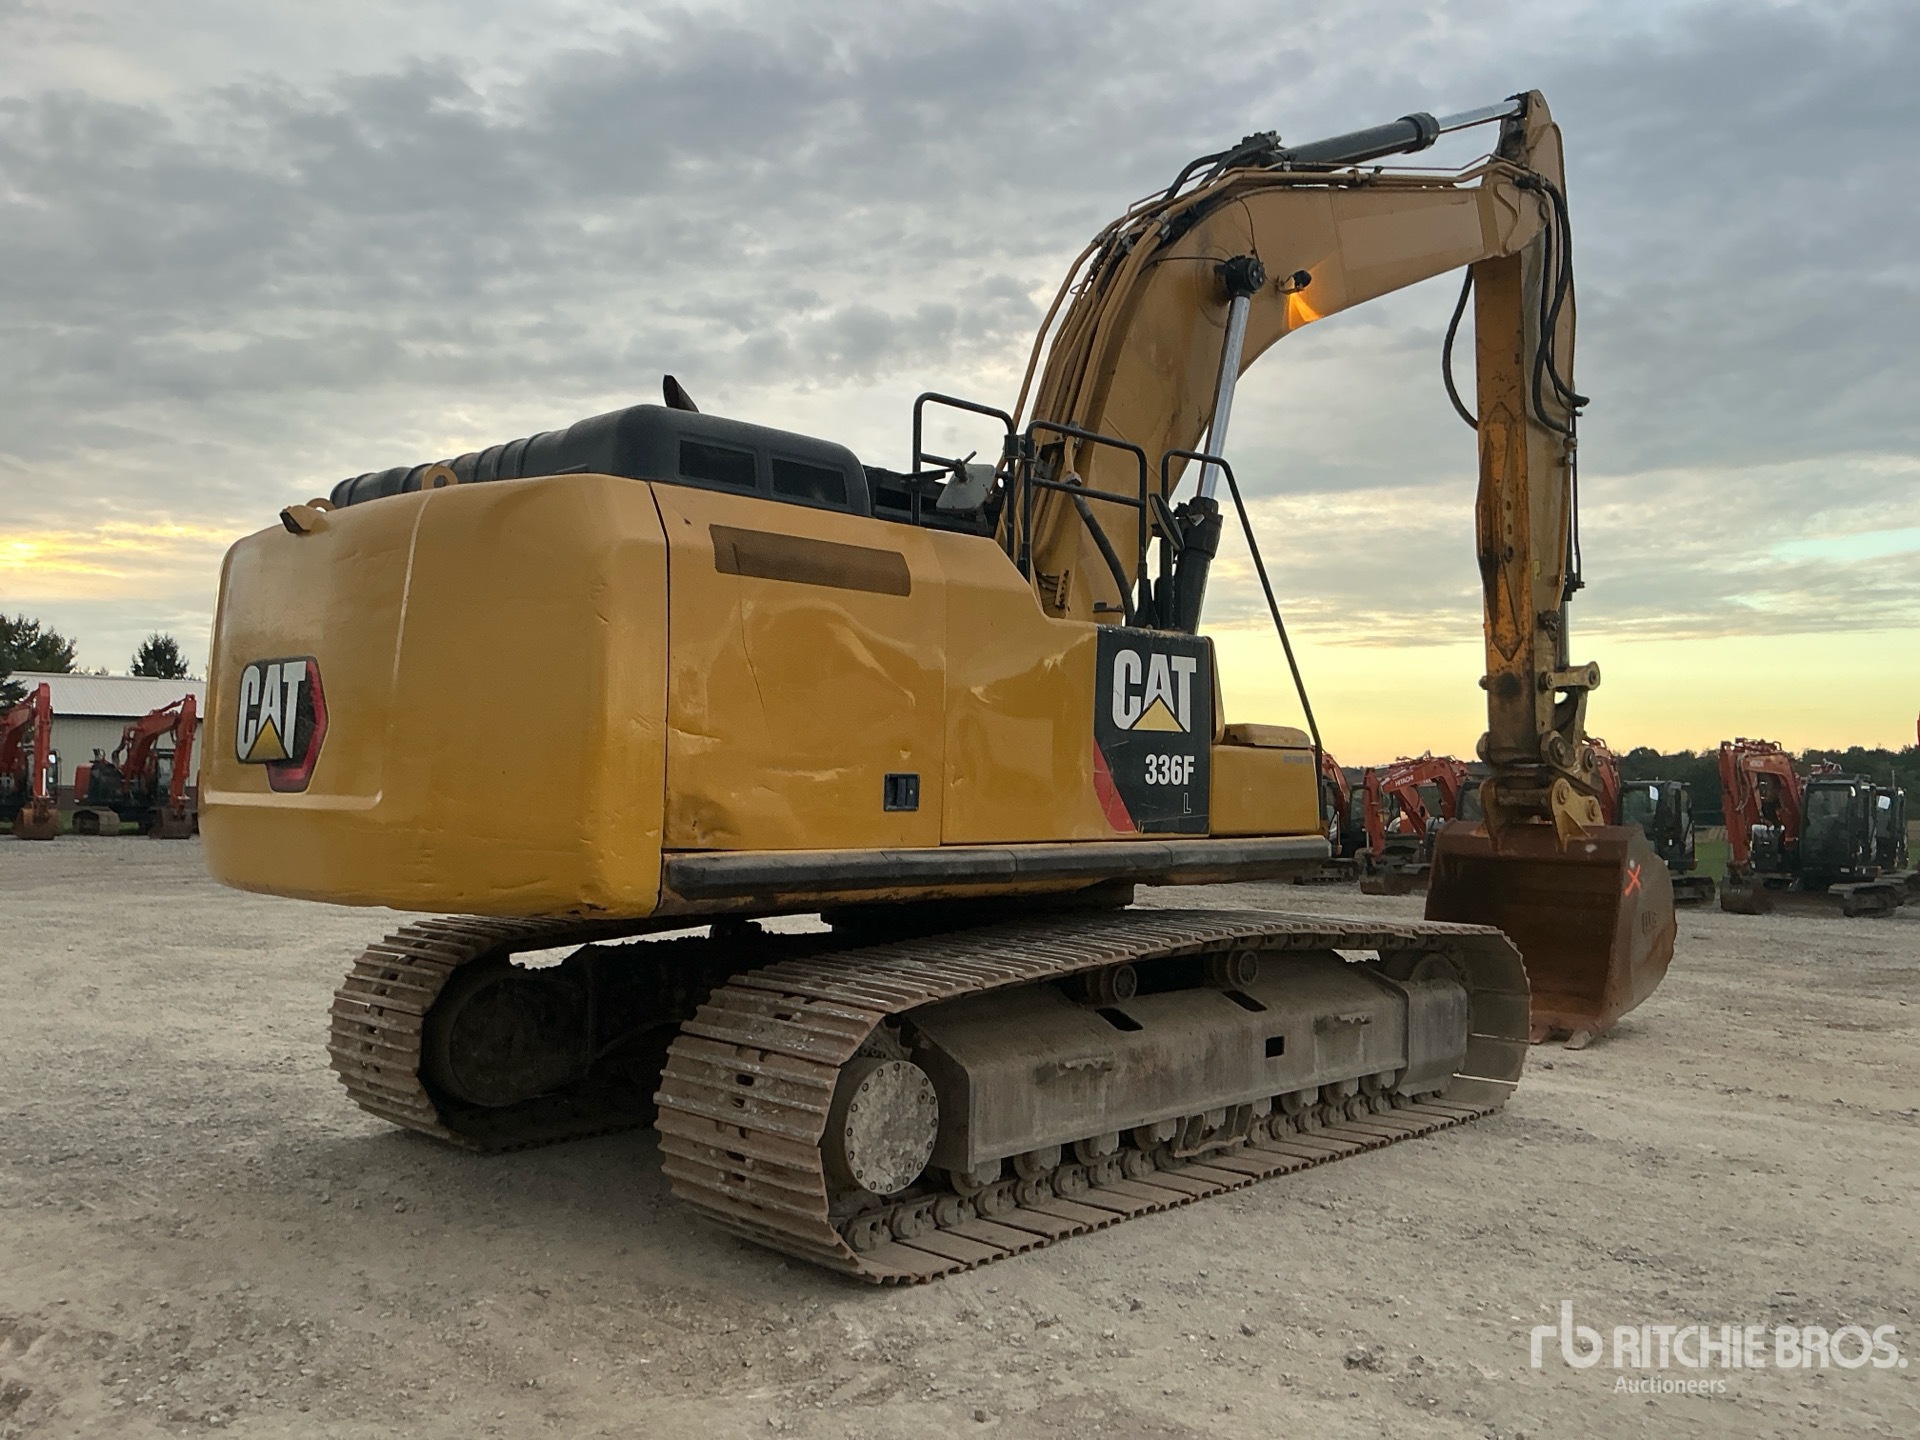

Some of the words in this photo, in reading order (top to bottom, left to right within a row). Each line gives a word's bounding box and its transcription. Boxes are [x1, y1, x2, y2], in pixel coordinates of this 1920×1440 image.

[1112, 649, 1197, 733] CAT
[236, 661, 307, 760] CAT
[1144, 753, 1195, 785] 336F
[1394, 774, 1414, 787] HITACHI
[1183, 792, 1192, 814] L
